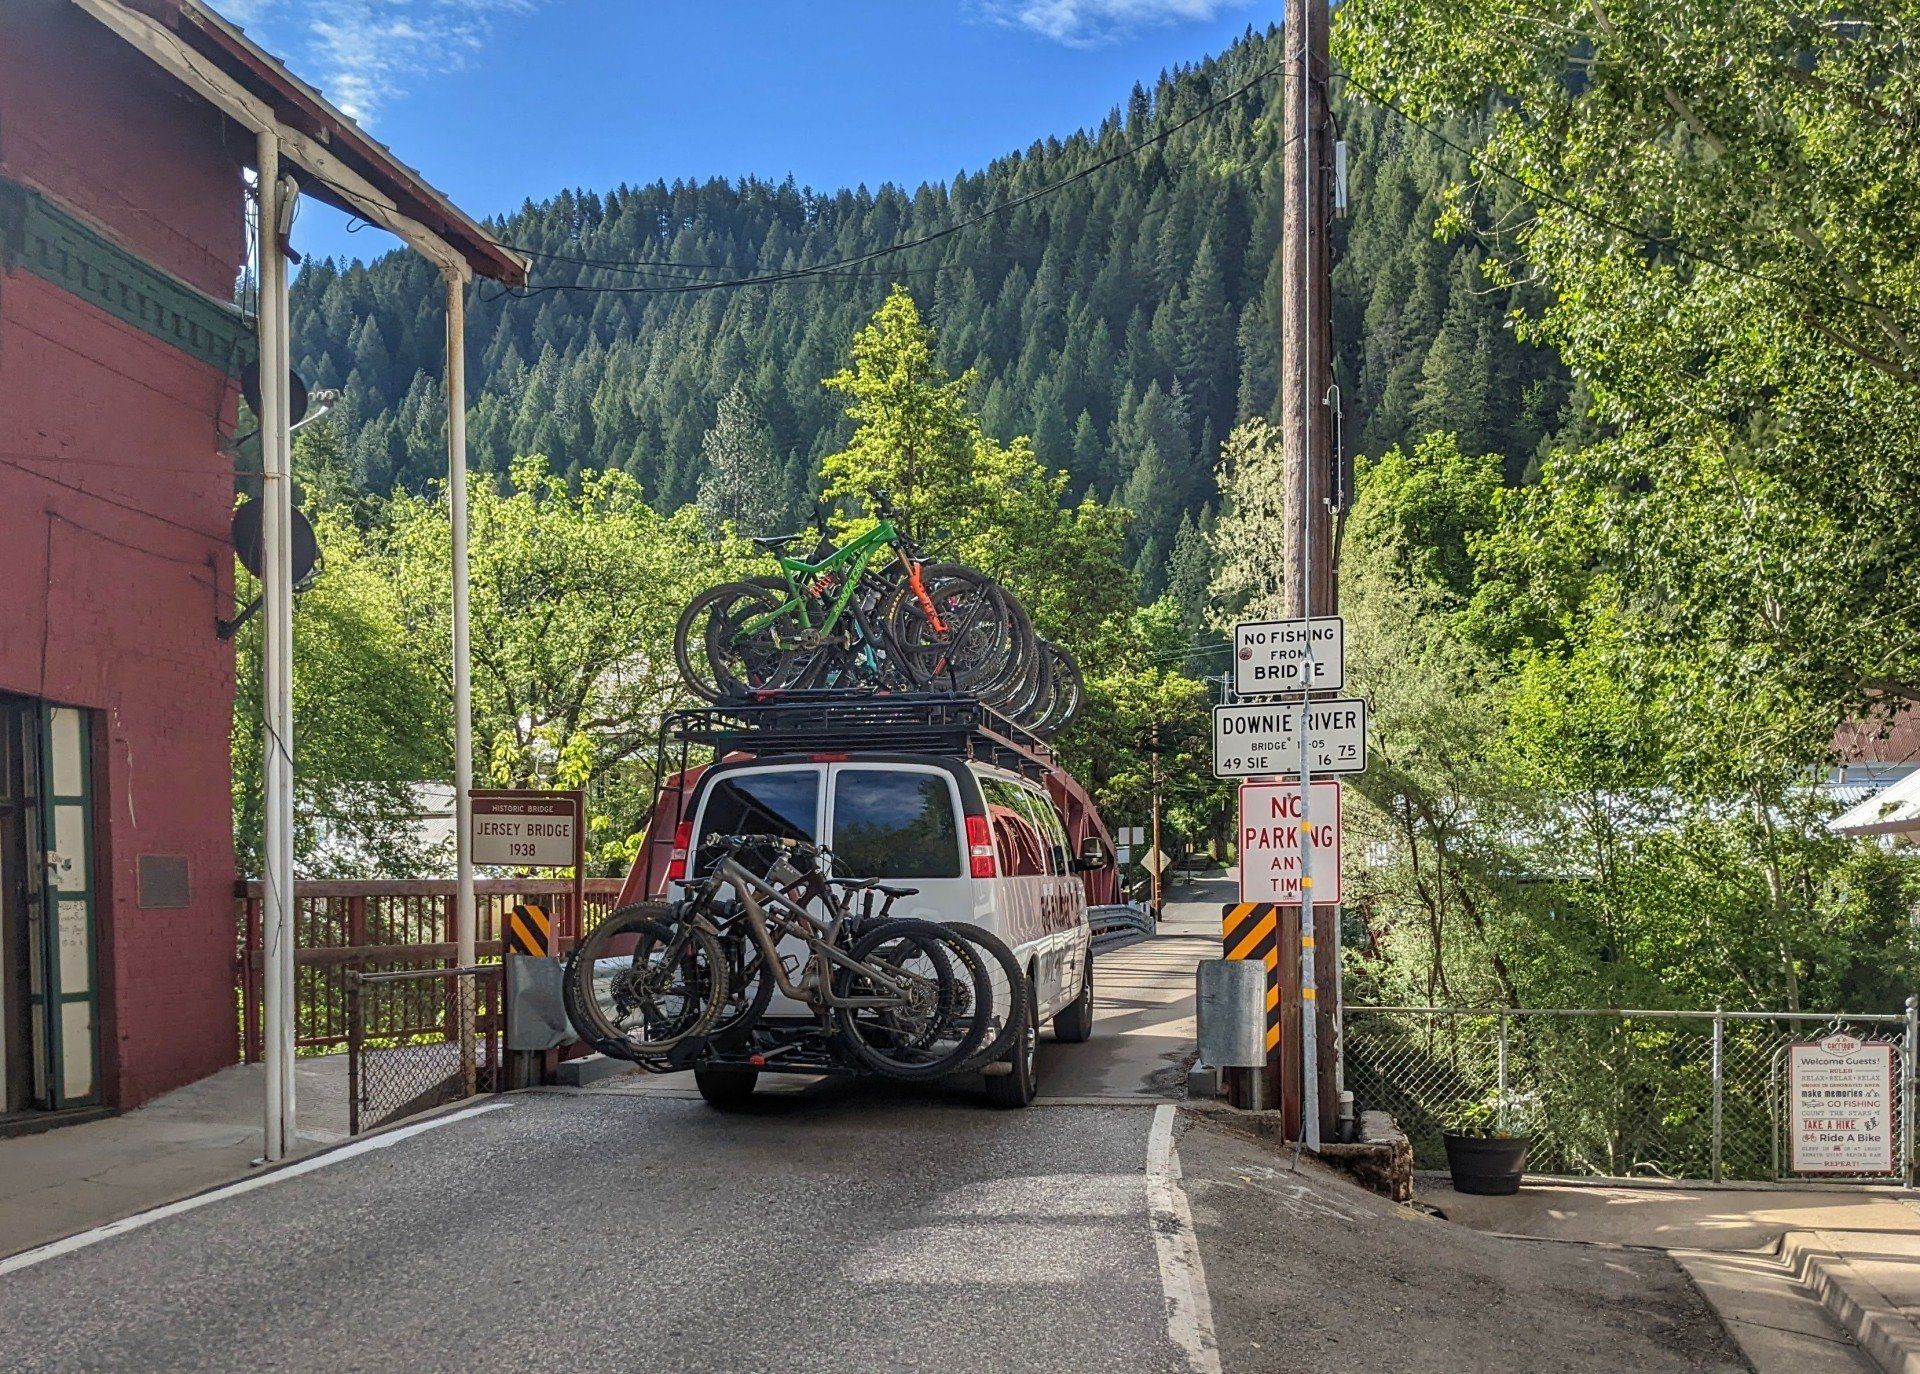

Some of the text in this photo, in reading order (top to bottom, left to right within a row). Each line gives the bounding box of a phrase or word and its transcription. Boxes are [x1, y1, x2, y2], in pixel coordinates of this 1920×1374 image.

[1244, 633, 1266, 646] NO
[1270, 650, 1307, 660] FROM
[1254, 662, 1325, 680] BRIDE
[1223, 714, 1293, 735] DOWNIE
[1251, 739, 1325, 751] BRIDGE 1-05
[1223, 745, 1357, 769] 49 SIE 16 75
[527, 805, 554, 813] BRIDGE
[1271, 796, 1302, 819] NO
[477, 822, 570, 837] JERSEY BRIDGE
[1245, 825, 1333, 849] PARKNG
[510, 843, 536, 856] 1938
[1271, 878, 1302, 892] TIM
[1846, 1057, 1880, 1065] Guests!
[1801, 1089, 1863, 1098] make memories
[1827, 1100, 1881, 1108] GO FISHING
[1803, 1120, 1856, 1130] TAKE A HIKE
[1820, 1133, 1881, 1142] Ride A Bike
